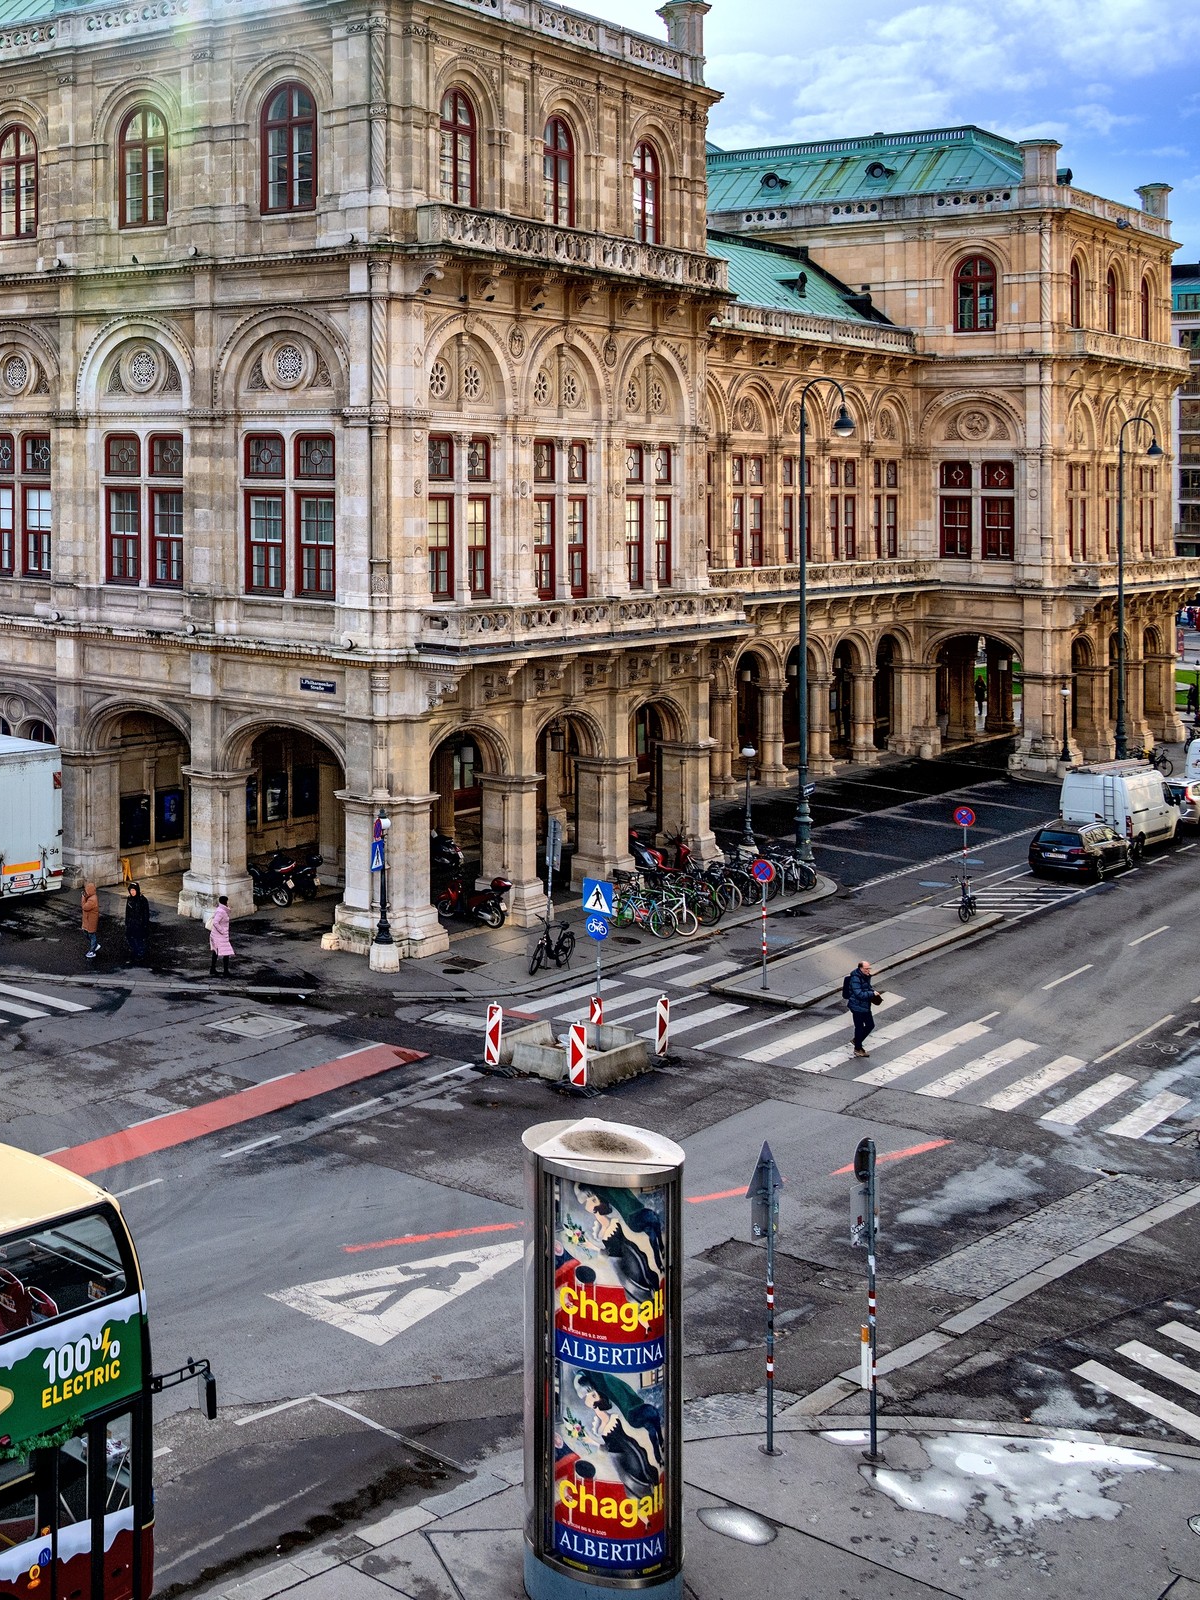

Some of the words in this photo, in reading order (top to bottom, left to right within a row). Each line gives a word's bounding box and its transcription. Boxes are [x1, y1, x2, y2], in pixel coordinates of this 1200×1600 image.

[560, 1286, 663, 1332] Chagall
[43, 1327, 120, 1384] 100%
[559, 1338, 663, 1366] ALBERTINA
[42, 1360, 120, 1409] ELECTRIC
[559, 1480, 663, 1528] Chagall
[40, 1550, 49, 1564] IN
[559, 1530, 663, 1562] ALBERTINA
